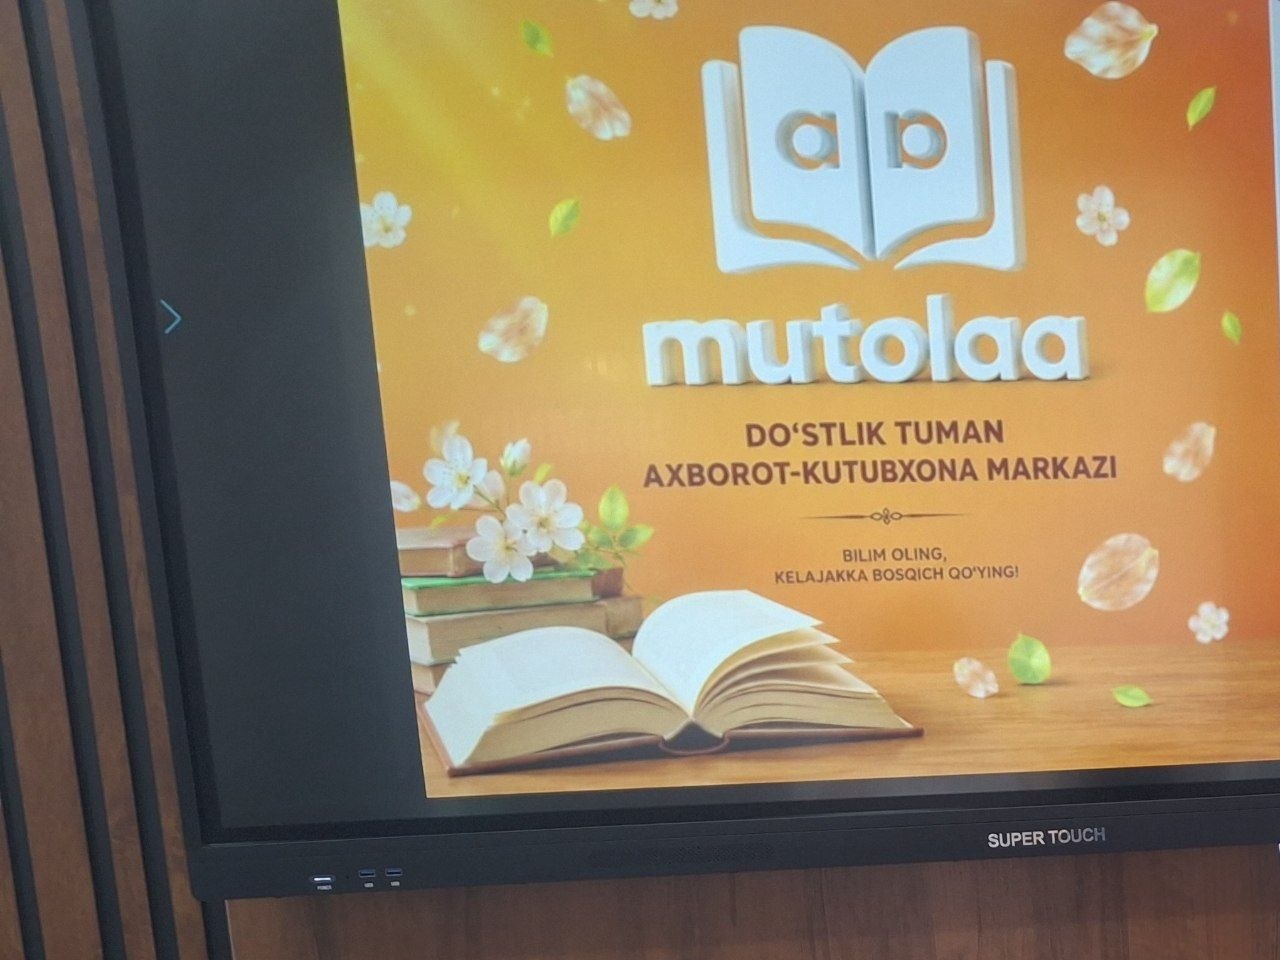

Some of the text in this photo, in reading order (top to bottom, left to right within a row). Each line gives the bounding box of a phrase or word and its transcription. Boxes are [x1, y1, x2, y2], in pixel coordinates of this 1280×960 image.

[643, 294, 1089, 387] mutolaa
[894, 419, 1004, 445] TUMAN
[643, 455, 1117, 488] AXBOROT-KUTUBXONA MARKAZI
[842, 547, 947, 563] BILIM OLING,
[774, 568, 867, 584] KELAJAKKA
[872, 567, 944, 582] BOSQICH
[988, 827, 1106, 848] SUPER TOUCH
